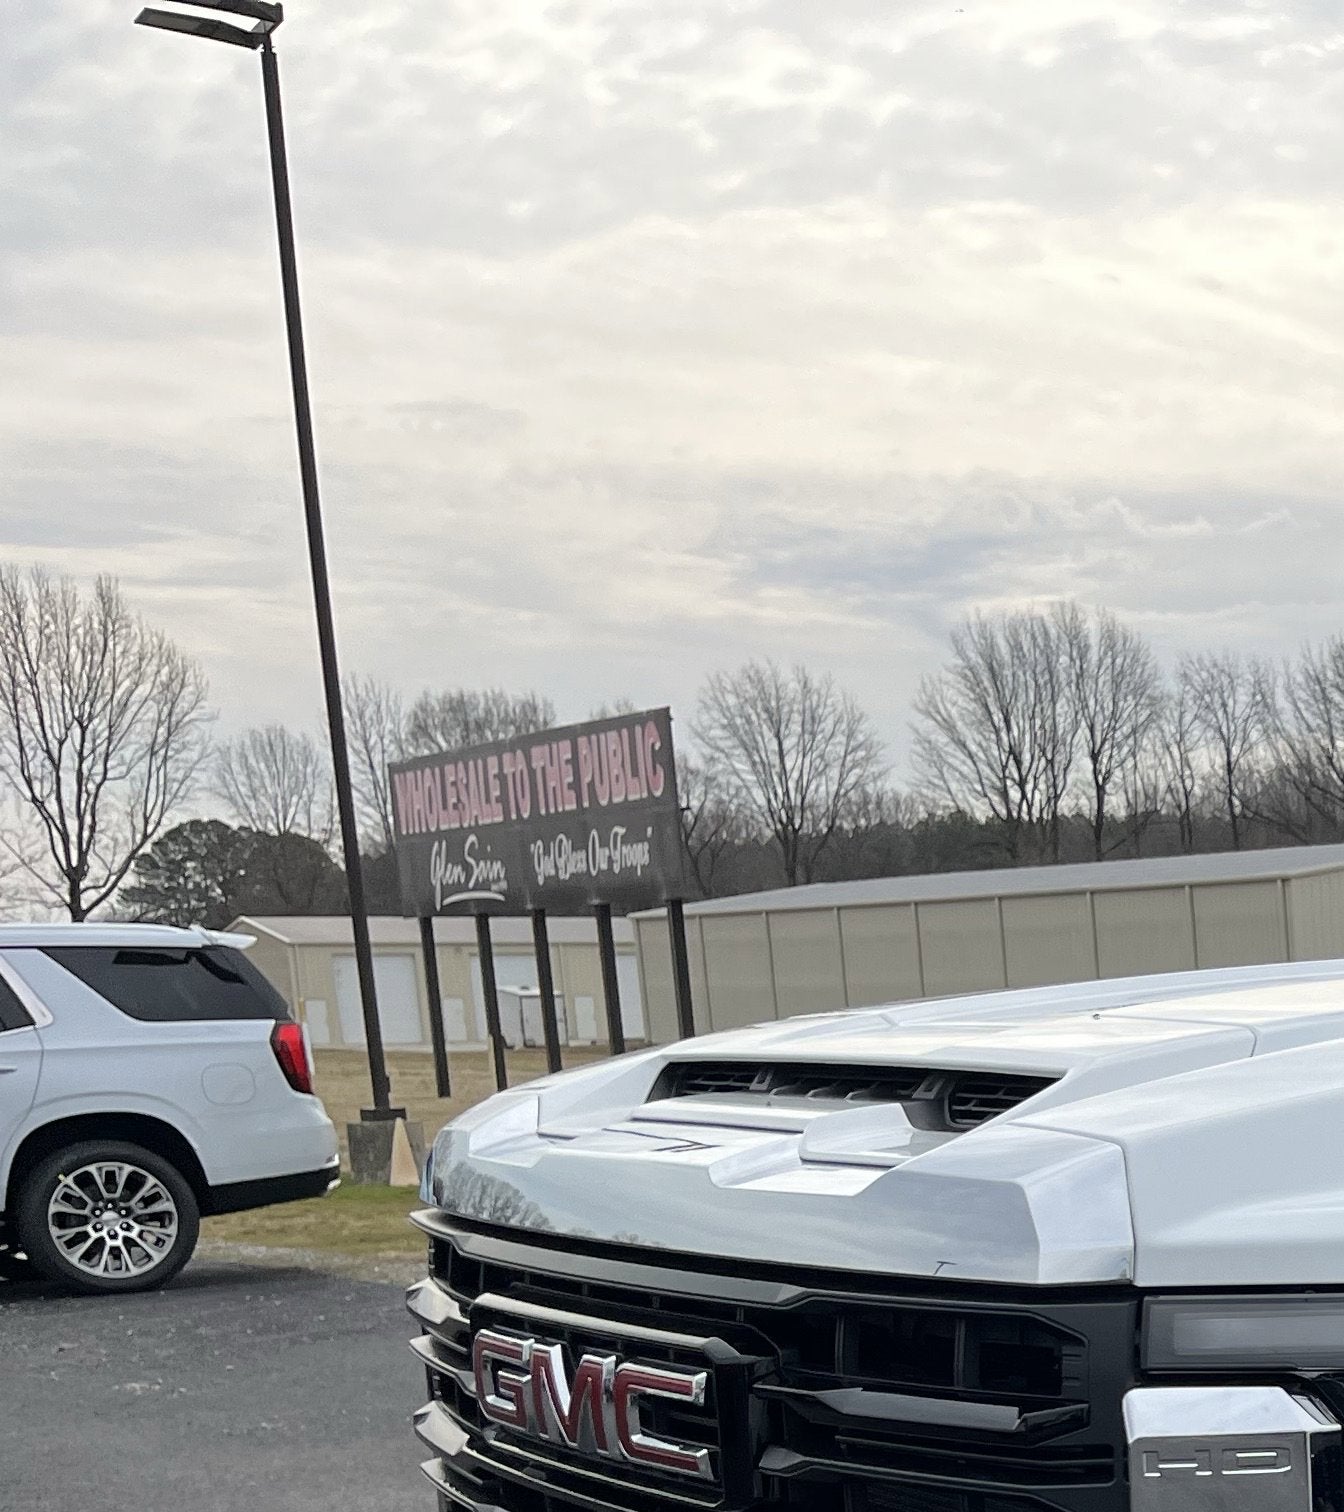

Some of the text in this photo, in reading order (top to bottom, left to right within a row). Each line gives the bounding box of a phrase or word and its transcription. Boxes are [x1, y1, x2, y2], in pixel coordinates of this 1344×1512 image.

[393, 720, 665, 836] WHOLESALE TO THE PUBLIC
[588, 828, 610, 877] Our
[473, 1328, 714, 1481] GMC
[1143, 1447, 1293, 1477] HD
